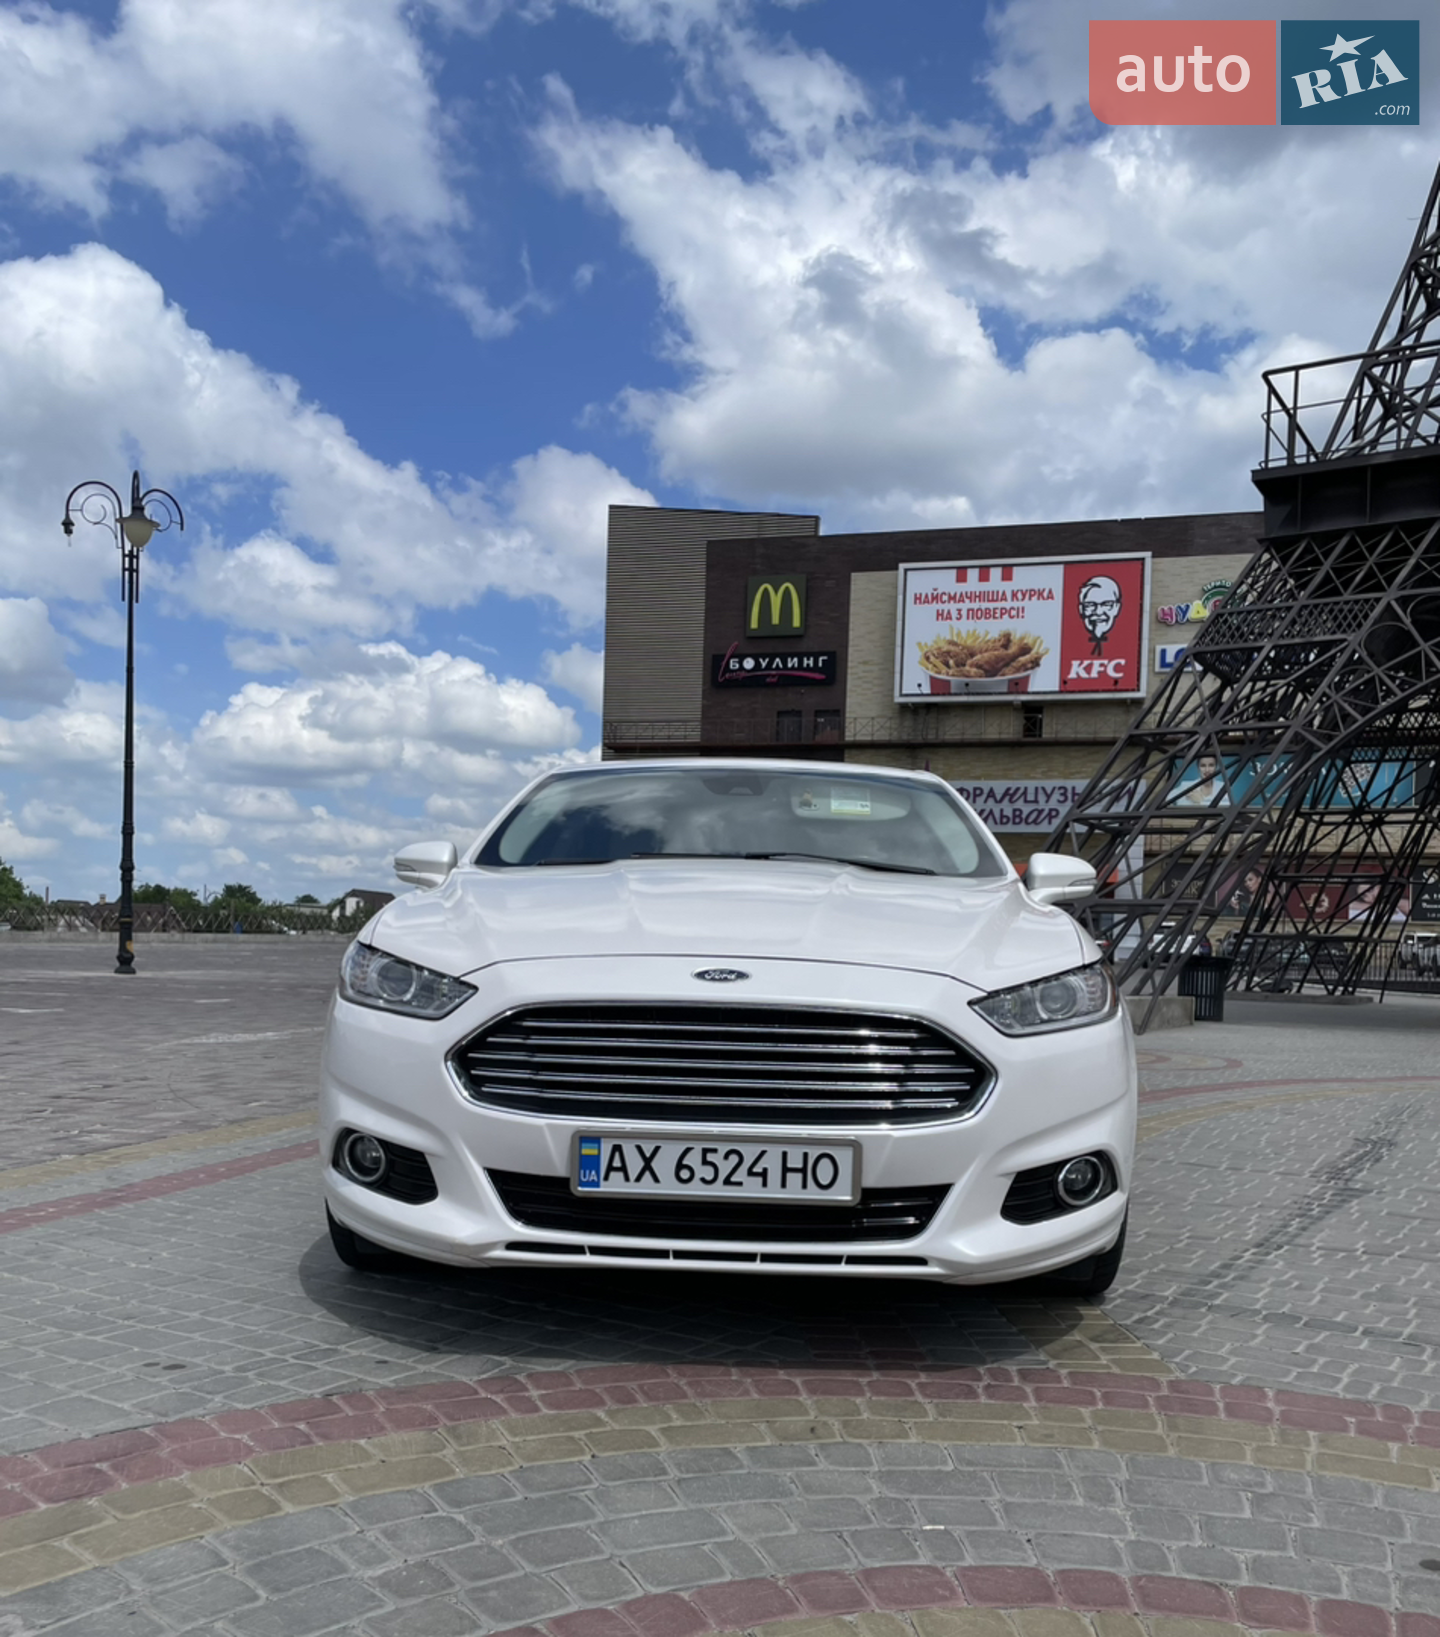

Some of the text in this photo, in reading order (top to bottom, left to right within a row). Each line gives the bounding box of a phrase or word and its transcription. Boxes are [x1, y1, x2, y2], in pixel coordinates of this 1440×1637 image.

[1203, 580, 1232, 592] ТЕРИТО
[914, 587, 1055, 605] НАЙСМАЧНІША КУРКА
[936, 606, 1025, 622] НА 3 ПОВЕРСІ!
[1158, 600, 1222, 626] ЧУД
[729, 656, 828, 670] БОУЛИНГ
[1068, 659, 1125, 679] KFC
[603, 1144, 662, 1183] AX
[674, 1147, 769, 1188] 6524
[580, 1170, 598, 1182] UA
